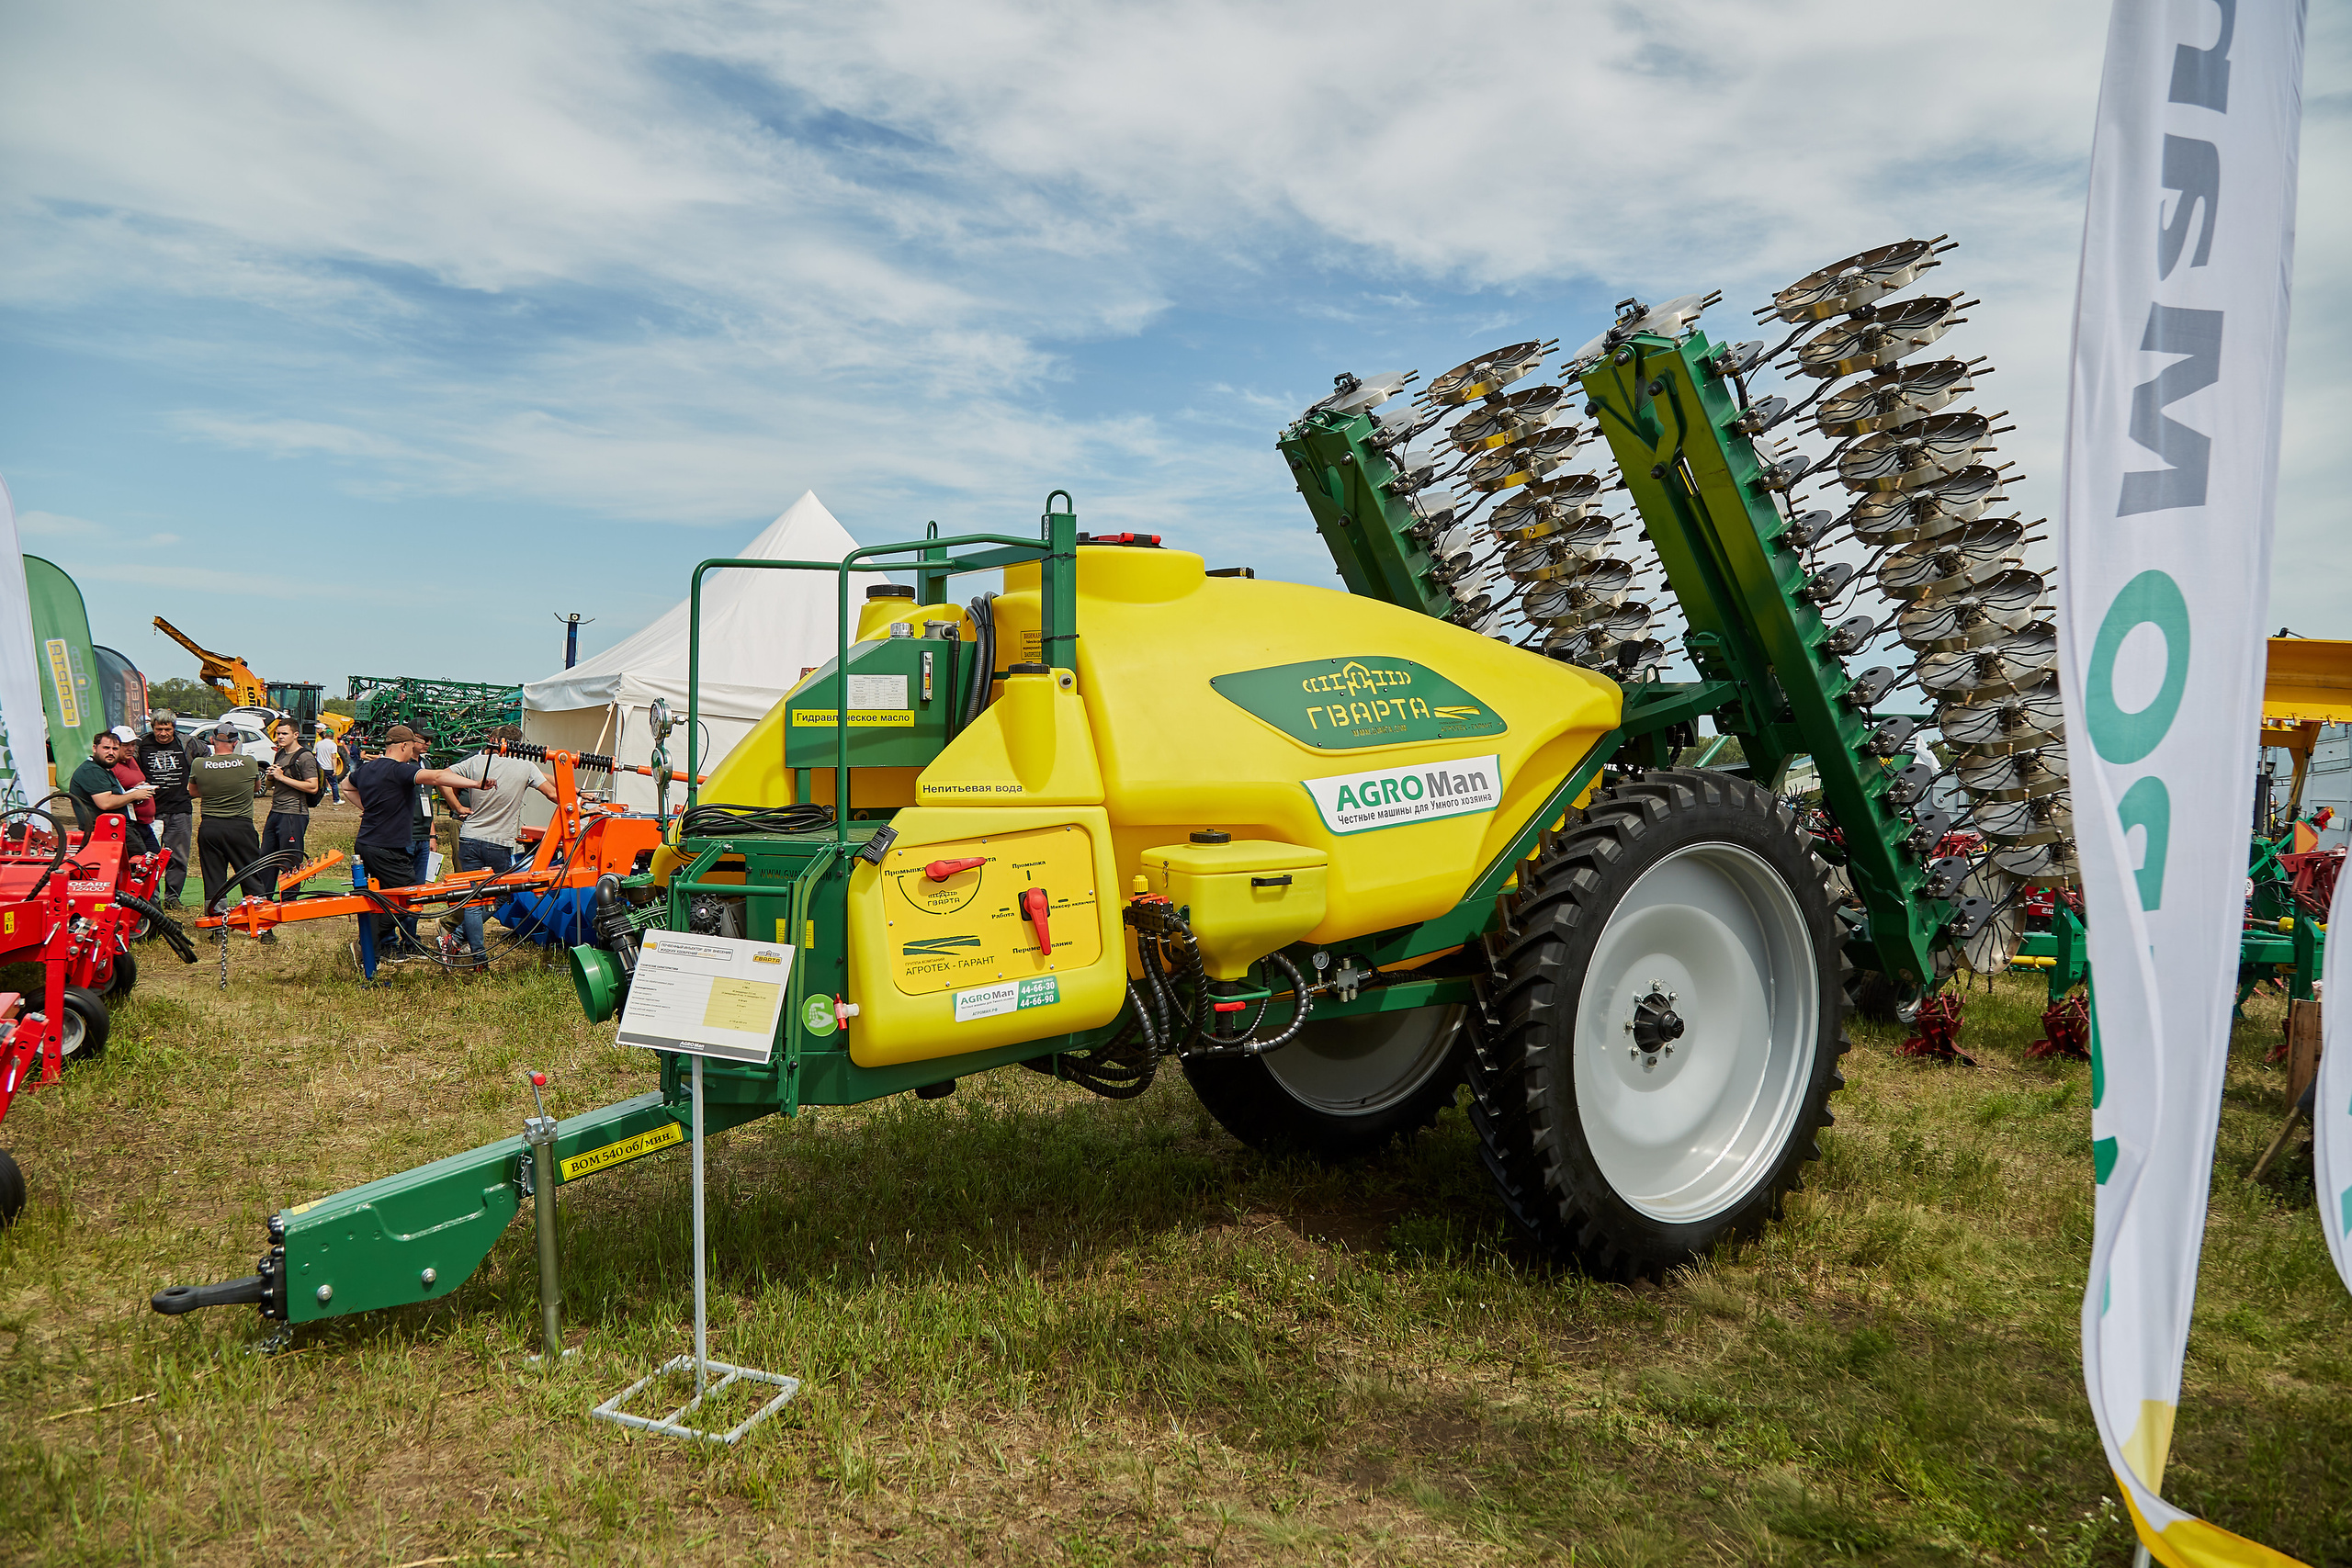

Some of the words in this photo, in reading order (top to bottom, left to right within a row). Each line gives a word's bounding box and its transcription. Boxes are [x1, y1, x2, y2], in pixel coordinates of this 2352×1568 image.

[130, 681, 141, 733] EXEED
[1306, 697, 1431, 729] ГВАРТА
[797, 713, 877, 723] Гидравлческое
[881, 714, 910, 722] масло
[204, 759, 245, 769] Reebok
[923, 785, 991, 793] Непитьевая
[1338, 813, 1375, 825] Честные
[1378, 807, 1412, 819] машины
[1414, 804, 1429, 815] для
[1430, 799, 1459, 811] Умного
[1461, 793, 1492, 806] хозяина
[1012, 860, 1046, 869] Промывка
[927, 897, 961, 906] ГВАРТА
[906, 963, 950, 976] АГРОТЕХ
[958, 956, 995, 969] ГАРАНТ
[1021, 981, 1055, 994] 44-66-30
[1020, 994, 1054, 1007] 44-66-90
[571, 1155, 600, 1173] ВОМ
[602, 1147, 623, 1162] 540
[625, 1133, 674, 1153] об/мин.
